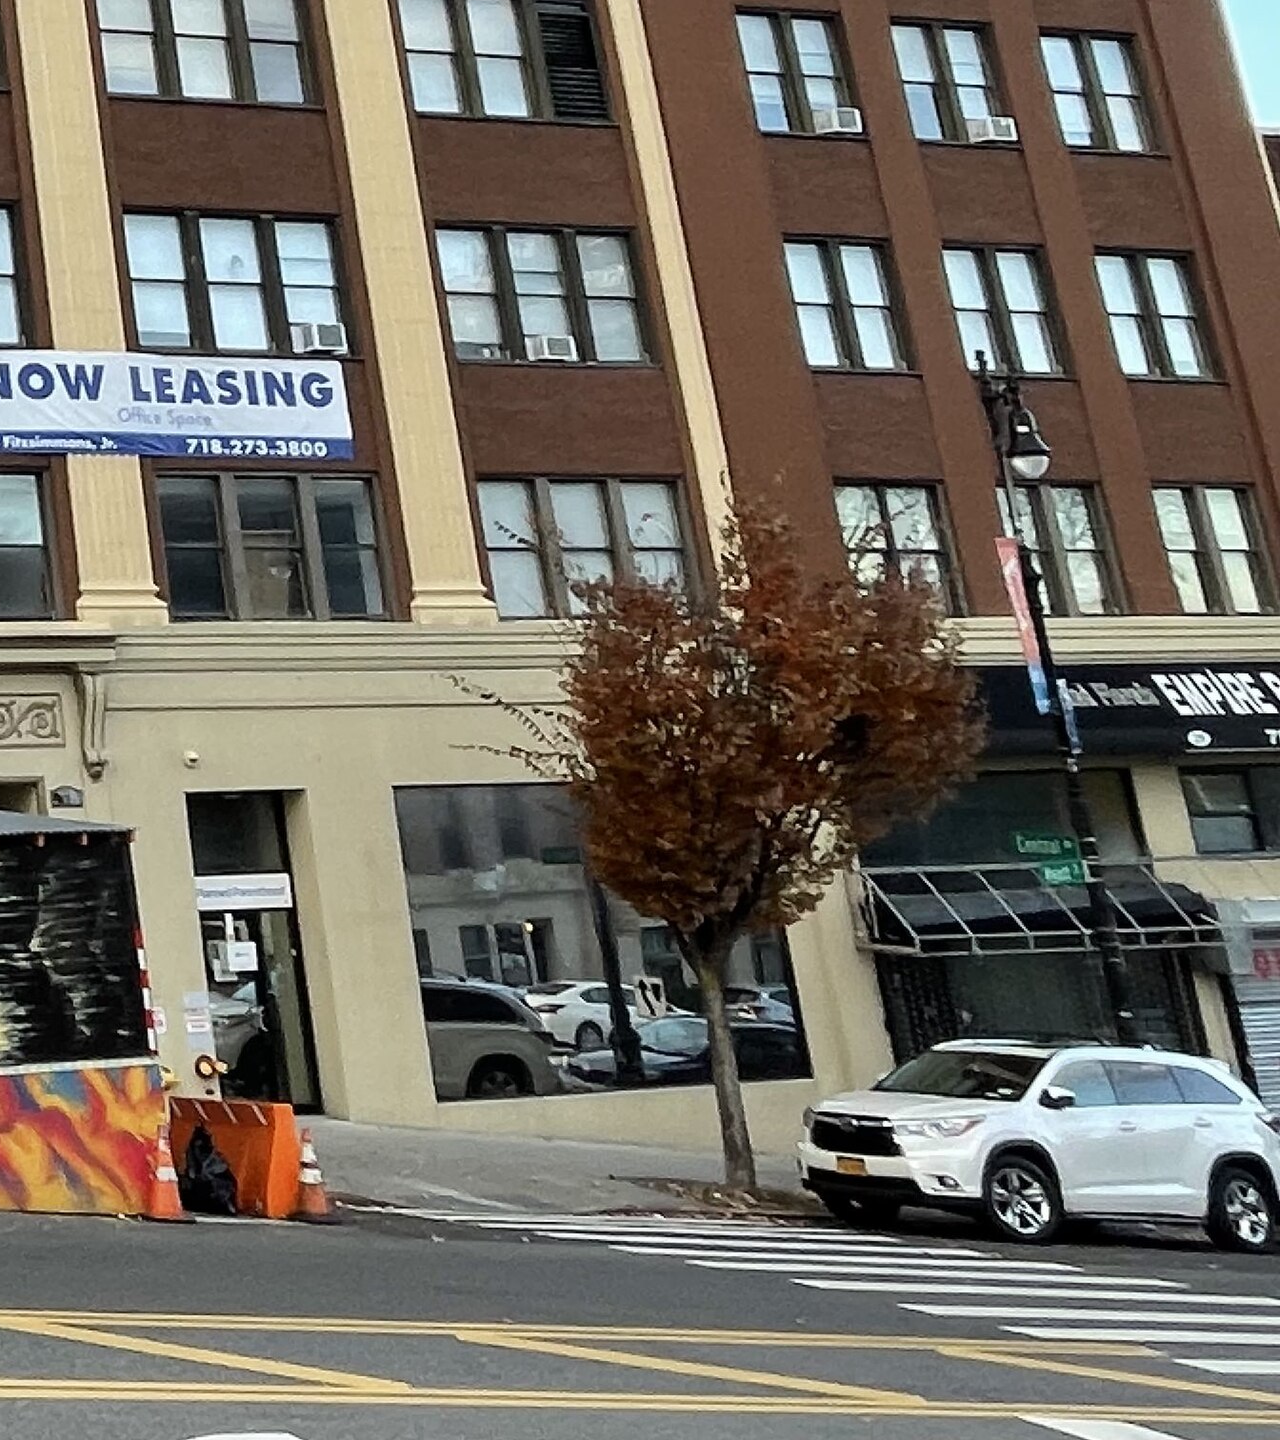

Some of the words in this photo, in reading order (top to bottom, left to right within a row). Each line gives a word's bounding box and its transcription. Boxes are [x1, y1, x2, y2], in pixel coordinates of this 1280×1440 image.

[129, 365, 333, 408] LEASING
[117, 407, 162, 424] Office
[167, 409, 213, 430] Space
[185, 437, 328, 458] 718.273.3800
[1150, 667, 1280, 716] EMPIRE
